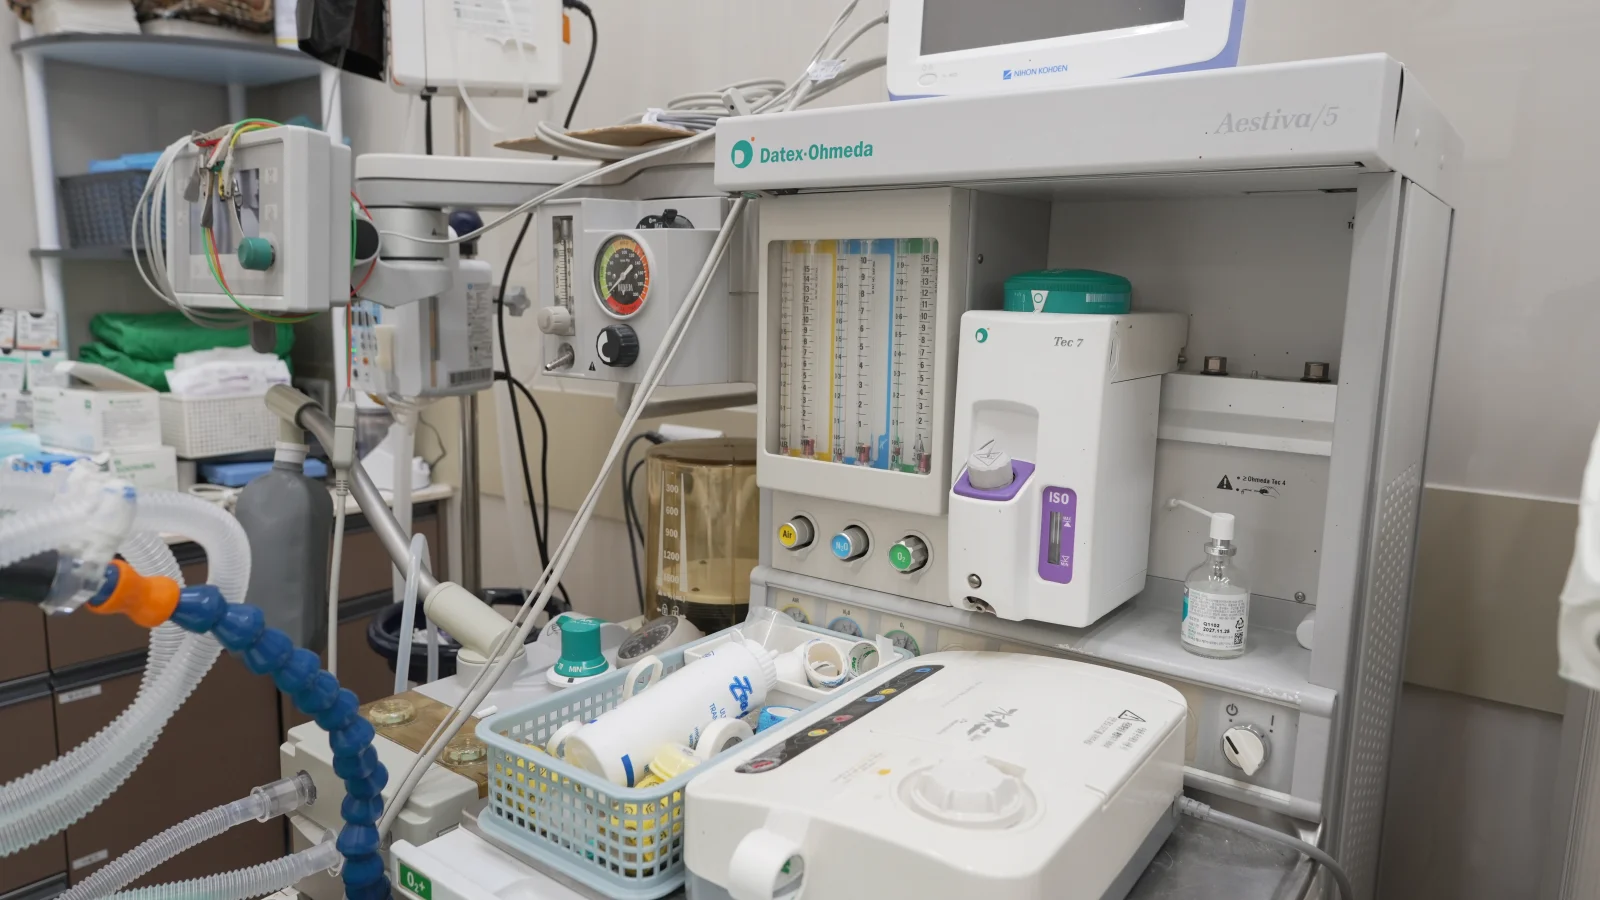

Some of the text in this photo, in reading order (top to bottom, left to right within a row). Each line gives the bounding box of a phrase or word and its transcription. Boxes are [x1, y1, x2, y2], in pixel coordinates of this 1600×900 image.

[1013, 65, 1068, 77] NIHON KOHDEN
[1213, 103, 1340, 135] Aestiva/5
[1054, 336, 1084, 348] Tec 7
[1248, 476, 1270, 484] Ohmeda
[666, 484, 678, 494] 300
[1049, 492, 1070, 504] ISO
[666, 506, 678, 516] 600
[665, 528, 678, 538] 900
[782, 530, 792, 539] Air
[664, 550, 680, 561] 1200
